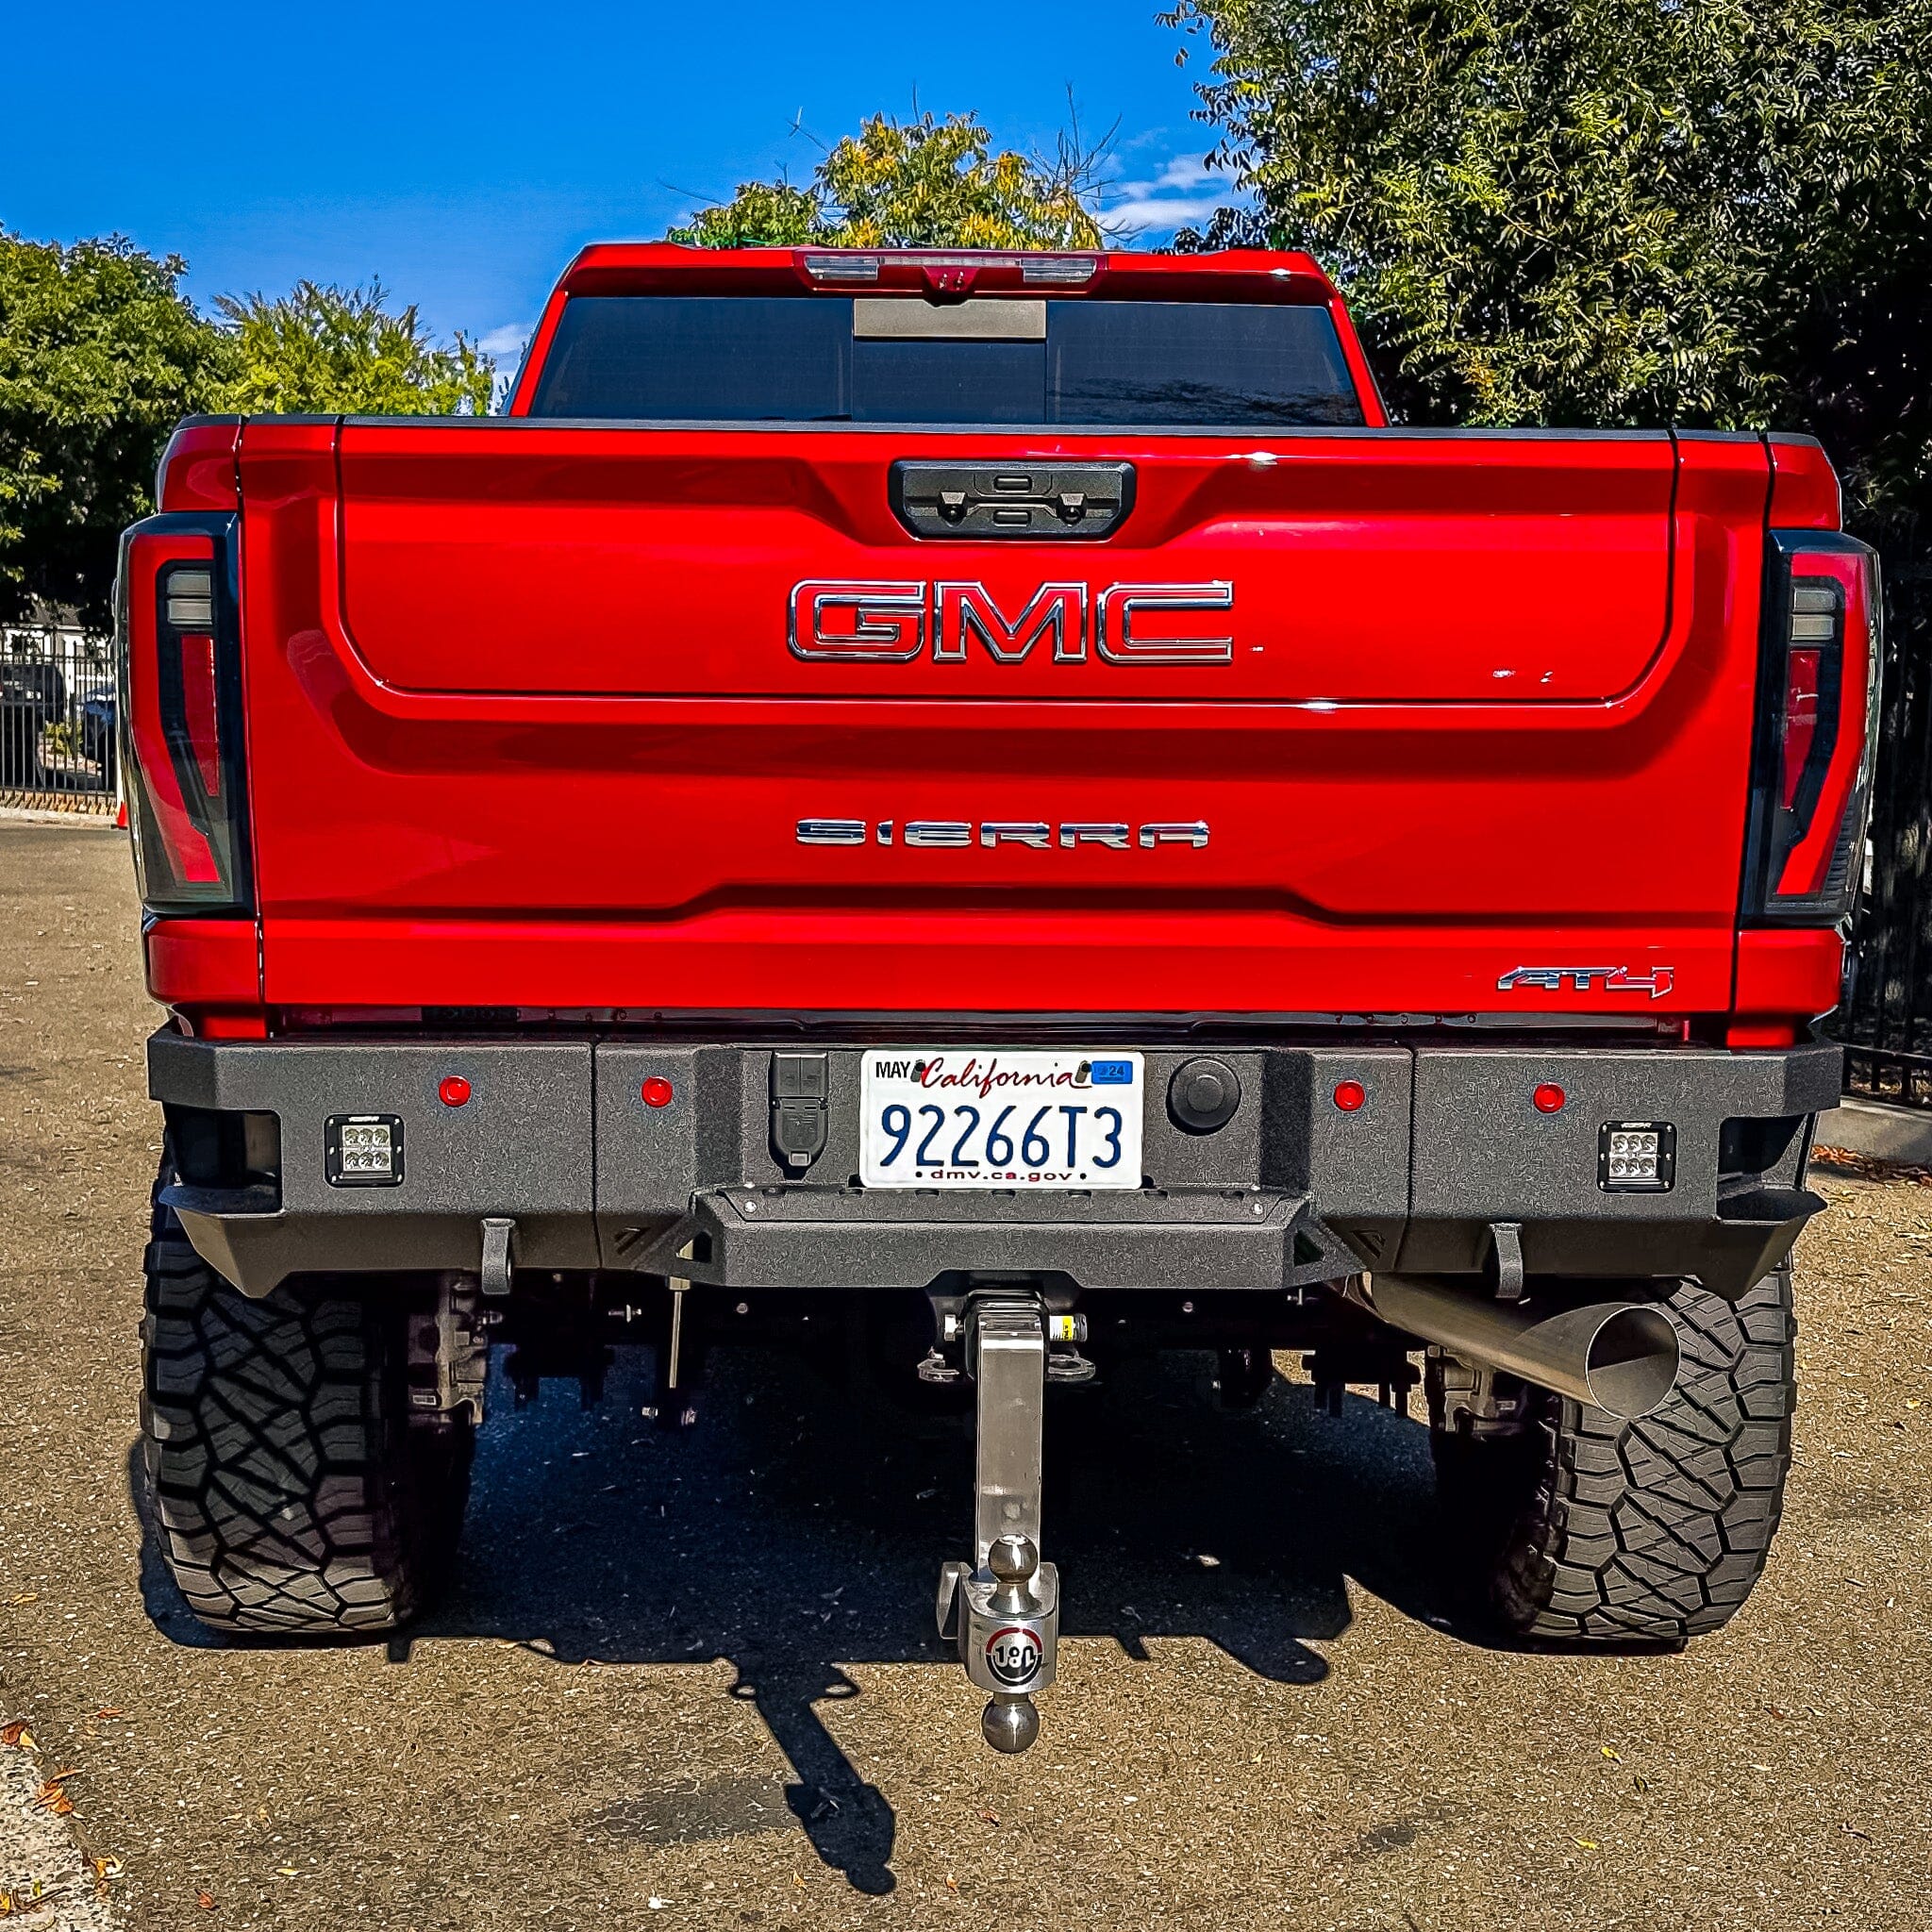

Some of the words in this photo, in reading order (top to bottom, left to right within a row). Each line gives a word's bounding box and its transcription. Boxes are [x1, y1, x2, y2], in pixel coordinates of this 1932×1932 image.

[789, 579, 1234, 664] GMC
[795, 819, 1211, 850] SIERRA
[1497, 965, 1675, 999] AT4
[875, 1061, 910, 1078] MAY
[922, 1057, 1092, 1098] California
[879, 1104, 1123, 1169] 92266T3
[930, 1169, 1073, 1182] dmv.ca.gov
